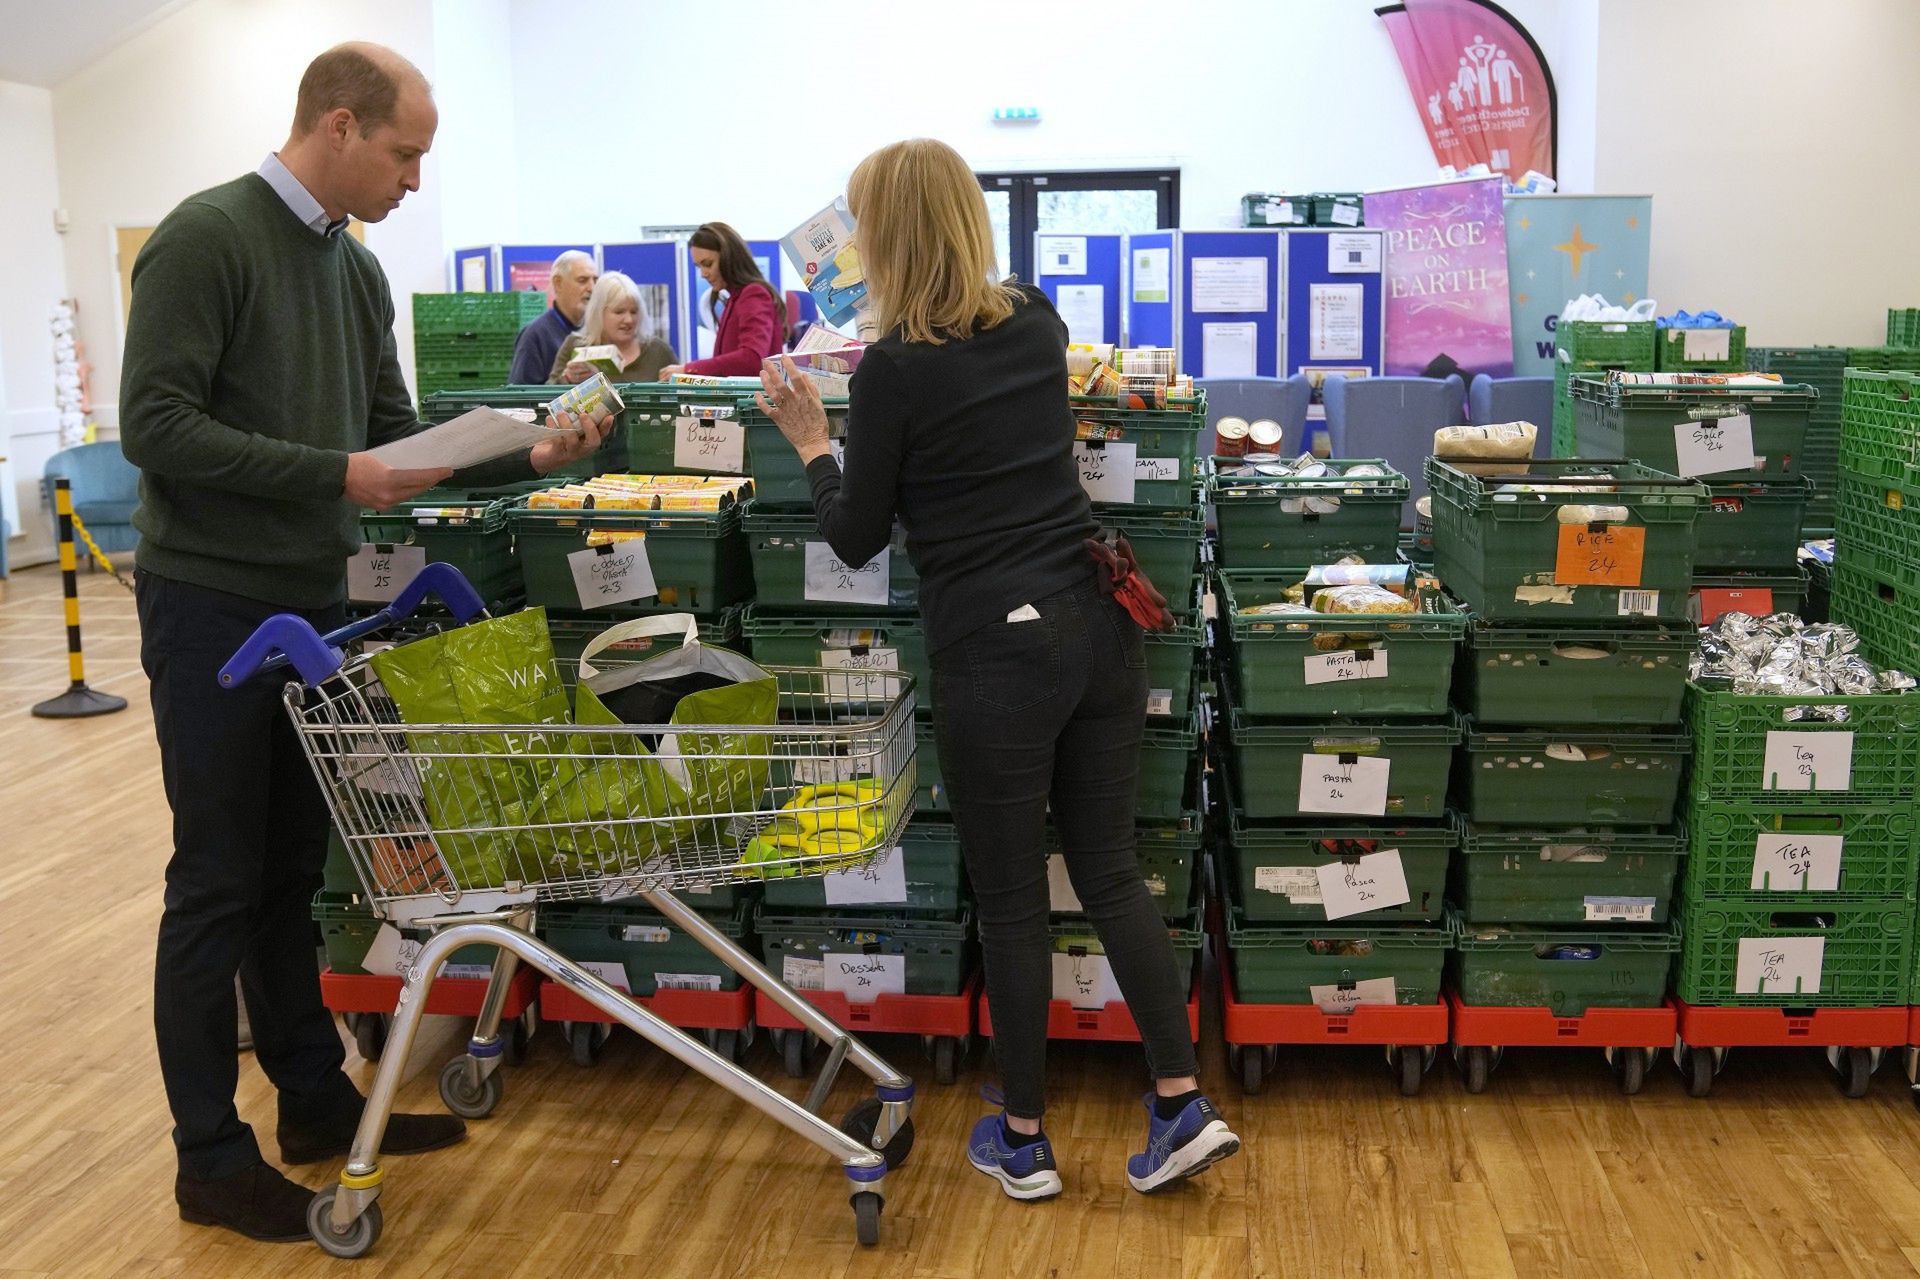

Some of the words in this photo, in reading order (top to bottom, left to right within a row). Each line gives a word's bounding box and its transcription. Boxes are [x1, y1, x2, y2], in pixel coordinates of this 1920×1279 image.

[1387, 221, 1487, 254] PEACE
[1424, 254, 1450, 269] ON
[1391, 268, 1488, 299] EARTH
[699, 443, 719, 457] 24
[1706, 442, 1725, 451] 24
[1083, 471, 1105, 480] 24
[1576, 532, 1614, 546] RICE
[370, 559, 391, 571] VEG
[1589, 558, 1617, 575] 24
[374, 575, 391, 588] 25
[599, 581, 621, 594] 23
[837, 574, 856, 590] 24
[1326, 655, 1354, 667] PASTA
[1337, 668, 1354, 679] 24
[852, 676, 877, 687] 24
[1793, 745, 1814, 761] Tea
[1798, 764, 1812, 776] 23
[1322, 774, 1353, 784] PASTA
[1330, 789, 1345, 799] 24
[1775, 843, 1811, 860] TEA
[1789, 860, 1811, 875] 24
[1358, 891, 1376, 901] 24
[1758, 950, 1785, 966] TEA
[1764, 967, 1782, 982] 24
[857, 976, 872, 987] 24
